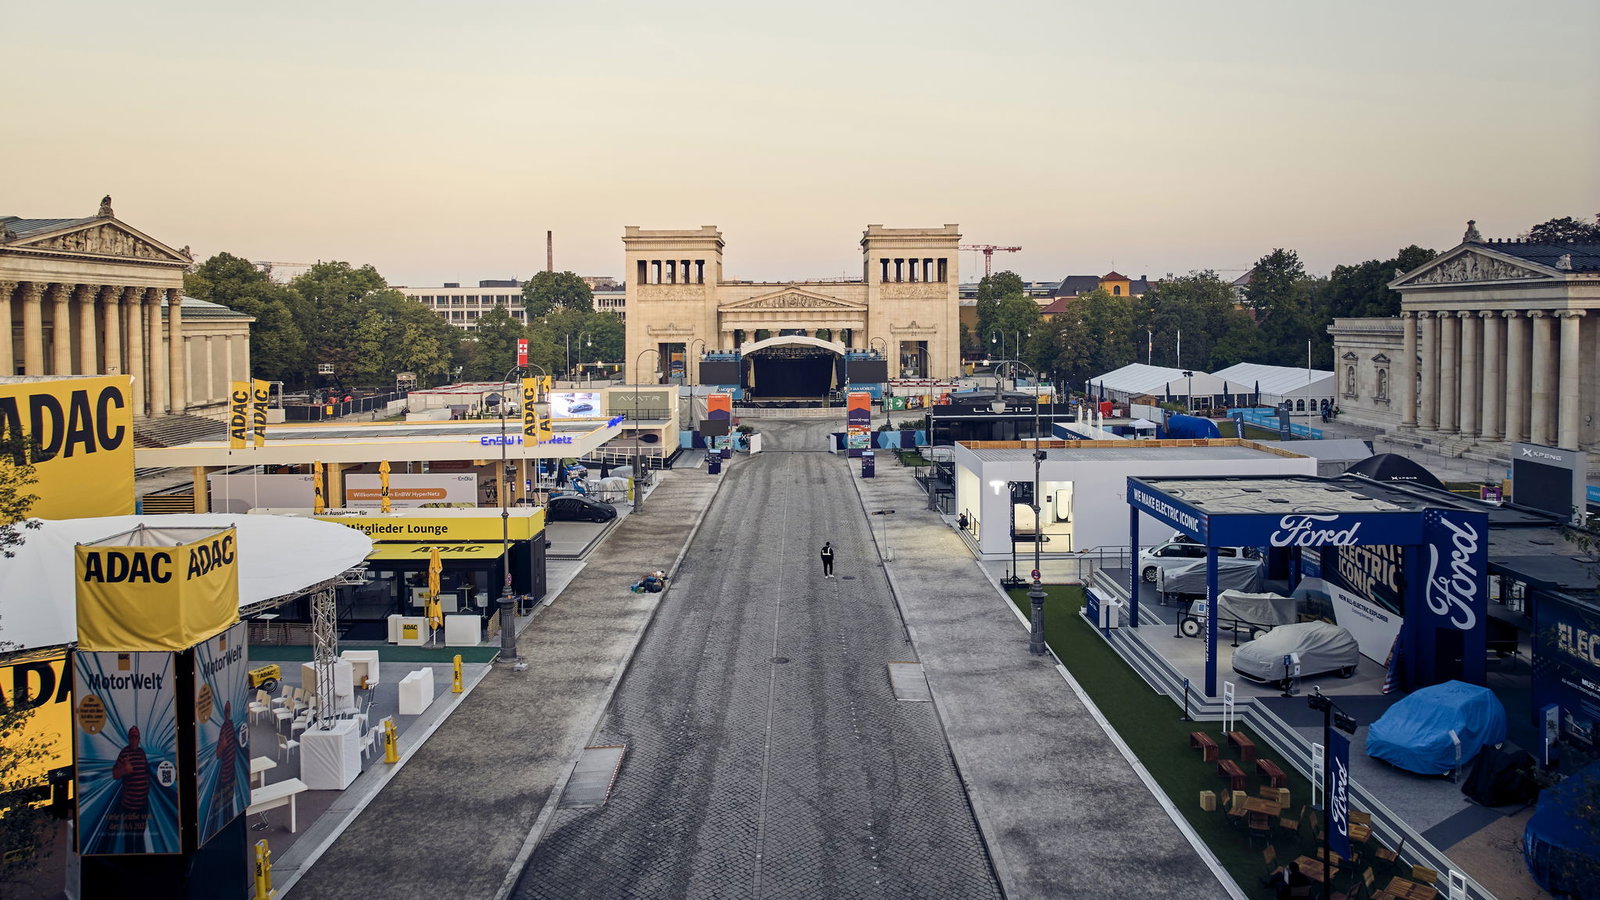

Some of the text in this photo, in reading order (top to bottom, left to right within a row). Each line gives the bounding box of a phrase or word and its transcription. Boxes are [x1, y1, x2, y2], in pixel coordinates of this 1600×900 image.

[231, 391, 248, 440] ADAC
[254, 389, 268, 438] ADAC
[524, 388, 536, 436] ADAC
[1533, 451, 1562, 461] XPENG
[407, 524, 448, 536] Lounge
[1134, 488, 1199, 533] WE MAKE ELECTRIC ICONIC
[1270, 515, 1361, 547] Ford
[84, 552, 172, 584] ADAC
[187, 535, 234, 581] ADAC
[1338, 545, 1398, 593] ELECTRIC
[1338, 556, 1376, 601] ICONIC
[1426, 516, 1479, 630] Ford
[1370, 608, 1389, 623] EXPLORER
[89, 673, 162, 690] MotorWelt
[203, 644, 242, 677] MotorWelt
[1331, 756, 1347, 837] Ford
